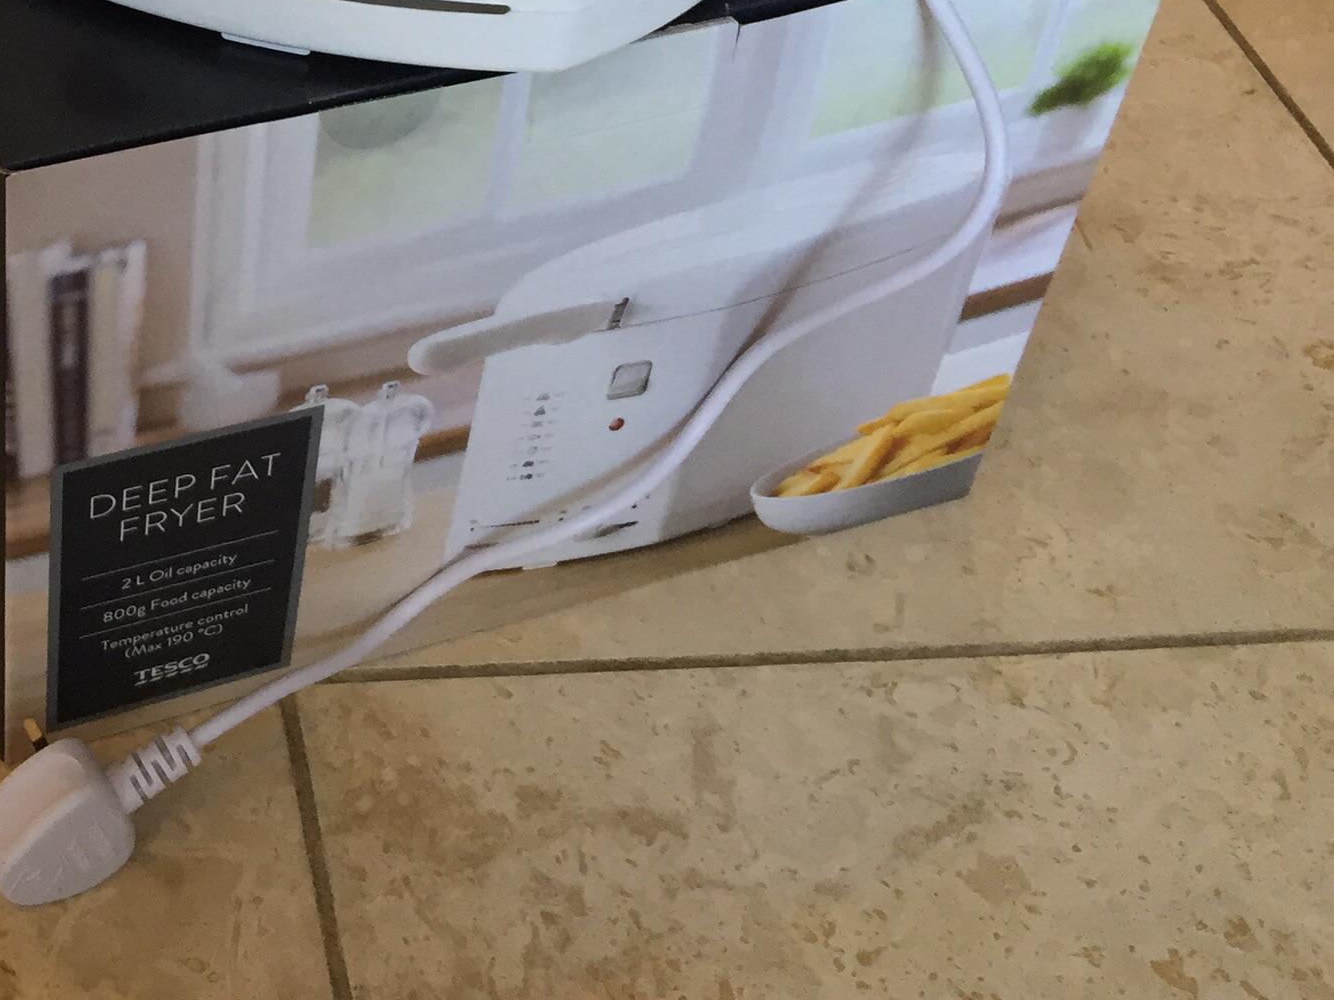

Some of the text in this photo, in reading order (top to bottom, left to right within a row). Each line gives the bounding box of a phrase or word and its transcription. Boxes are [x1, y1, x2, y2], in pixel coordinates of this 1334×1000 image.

[89, 452, 282, 519] DEEP FAT
[119, 492, 246, 542] FRYER
[121, 552, 238, 590] 2 L Oil capacity
[102, 577, 252, 624] 800g Food capacity
[101, 604, 249, 651] Temperature control
[125, 641, 163, 660] (Max
[166, 629, 194, 647] 190
[134, 652, 211, 686] TESCO
